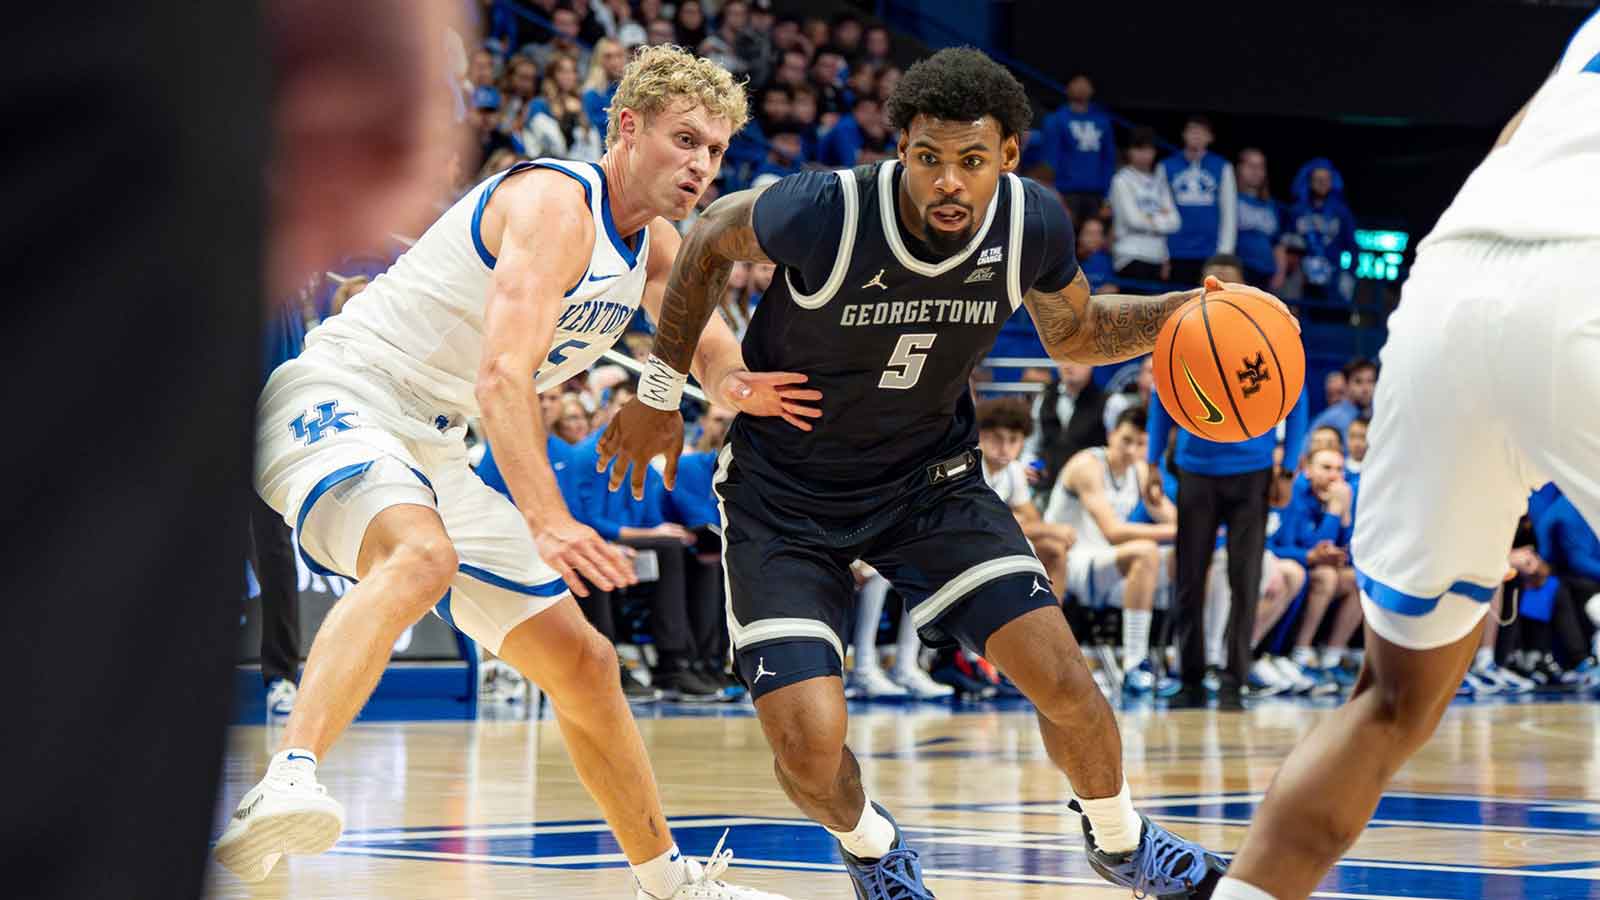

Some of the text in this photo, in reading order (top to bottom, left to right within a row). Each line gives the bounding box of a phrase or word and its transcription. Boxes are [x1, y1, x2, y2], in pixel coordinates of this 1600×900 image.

[840, 299, 998, 326] GEORGETOWN
[877, 333, 938, 390] 5
[288, 400, 360, 447] UK
